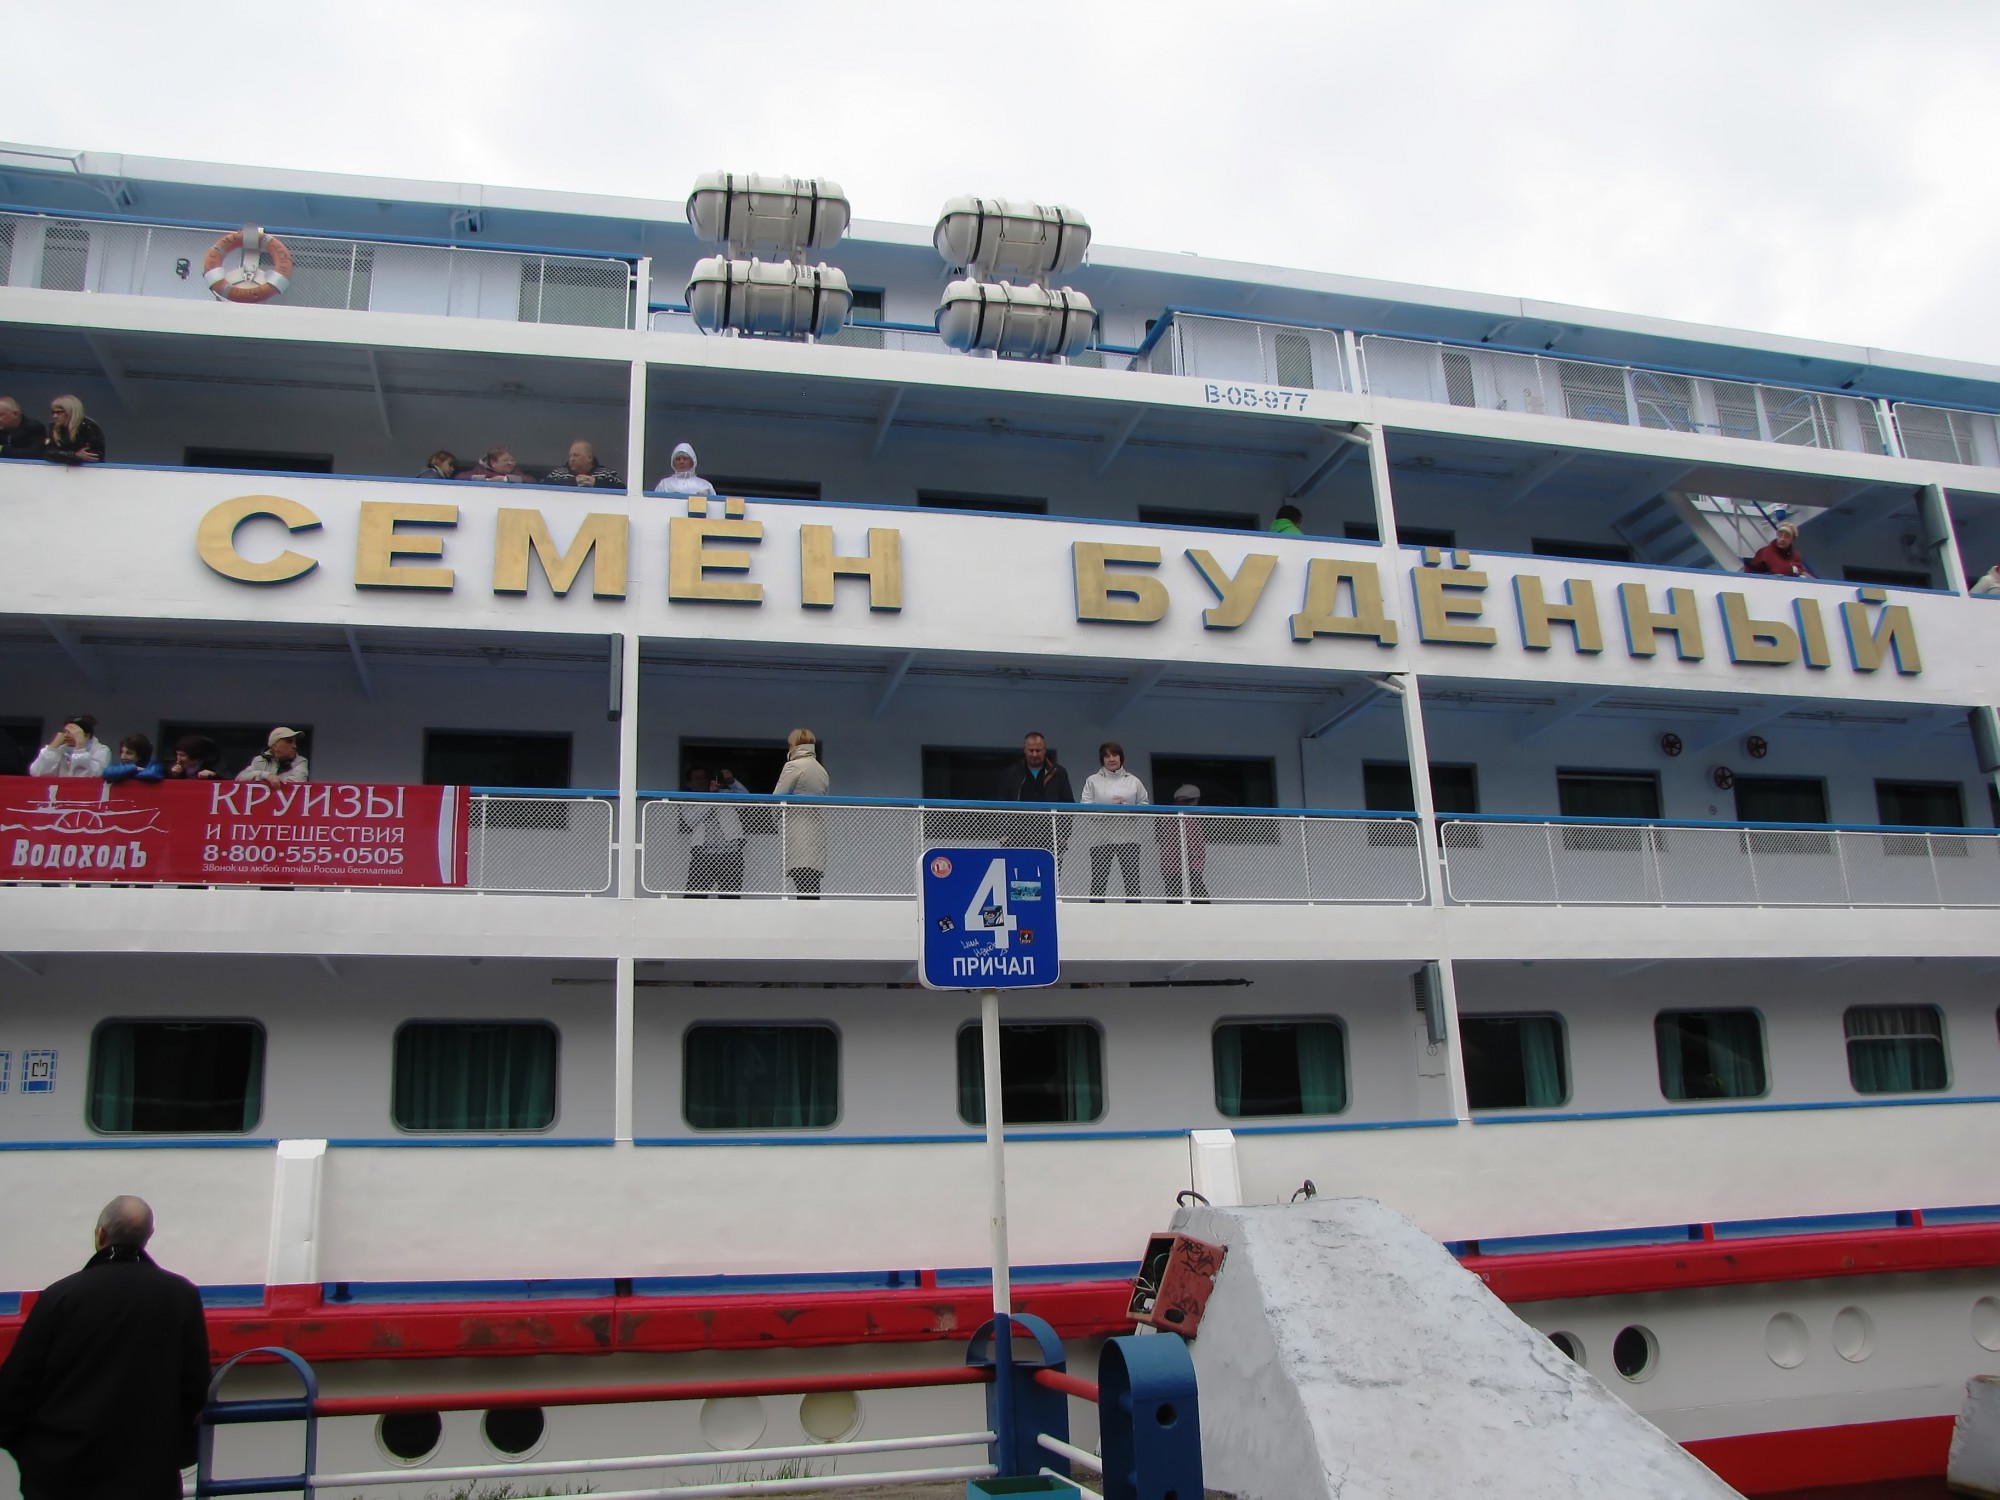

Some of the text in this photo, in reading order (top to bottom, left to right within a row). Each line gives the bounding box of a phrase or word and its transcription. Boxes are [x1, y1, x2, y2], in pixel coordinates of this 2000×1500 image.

[198, 494, 1923, 676] СЕМЁН БУДЁННЫЙ
[207, 782, 405, 818] КРУИЗЫ
[203, 824, 404, 843] И ПУТЕШЕСТВИЯ
[202, 863, 236, 872] Звонок
[250, 864, 279, 872] любой
[281, 865, 311, 873] точки
[313, 865, 345, 874] России
[347, 866, 404, 875] бесплатный
[965, 858, 1017, 949] 4
[953, 956, 1035, 977] ПРИЧАЛ
